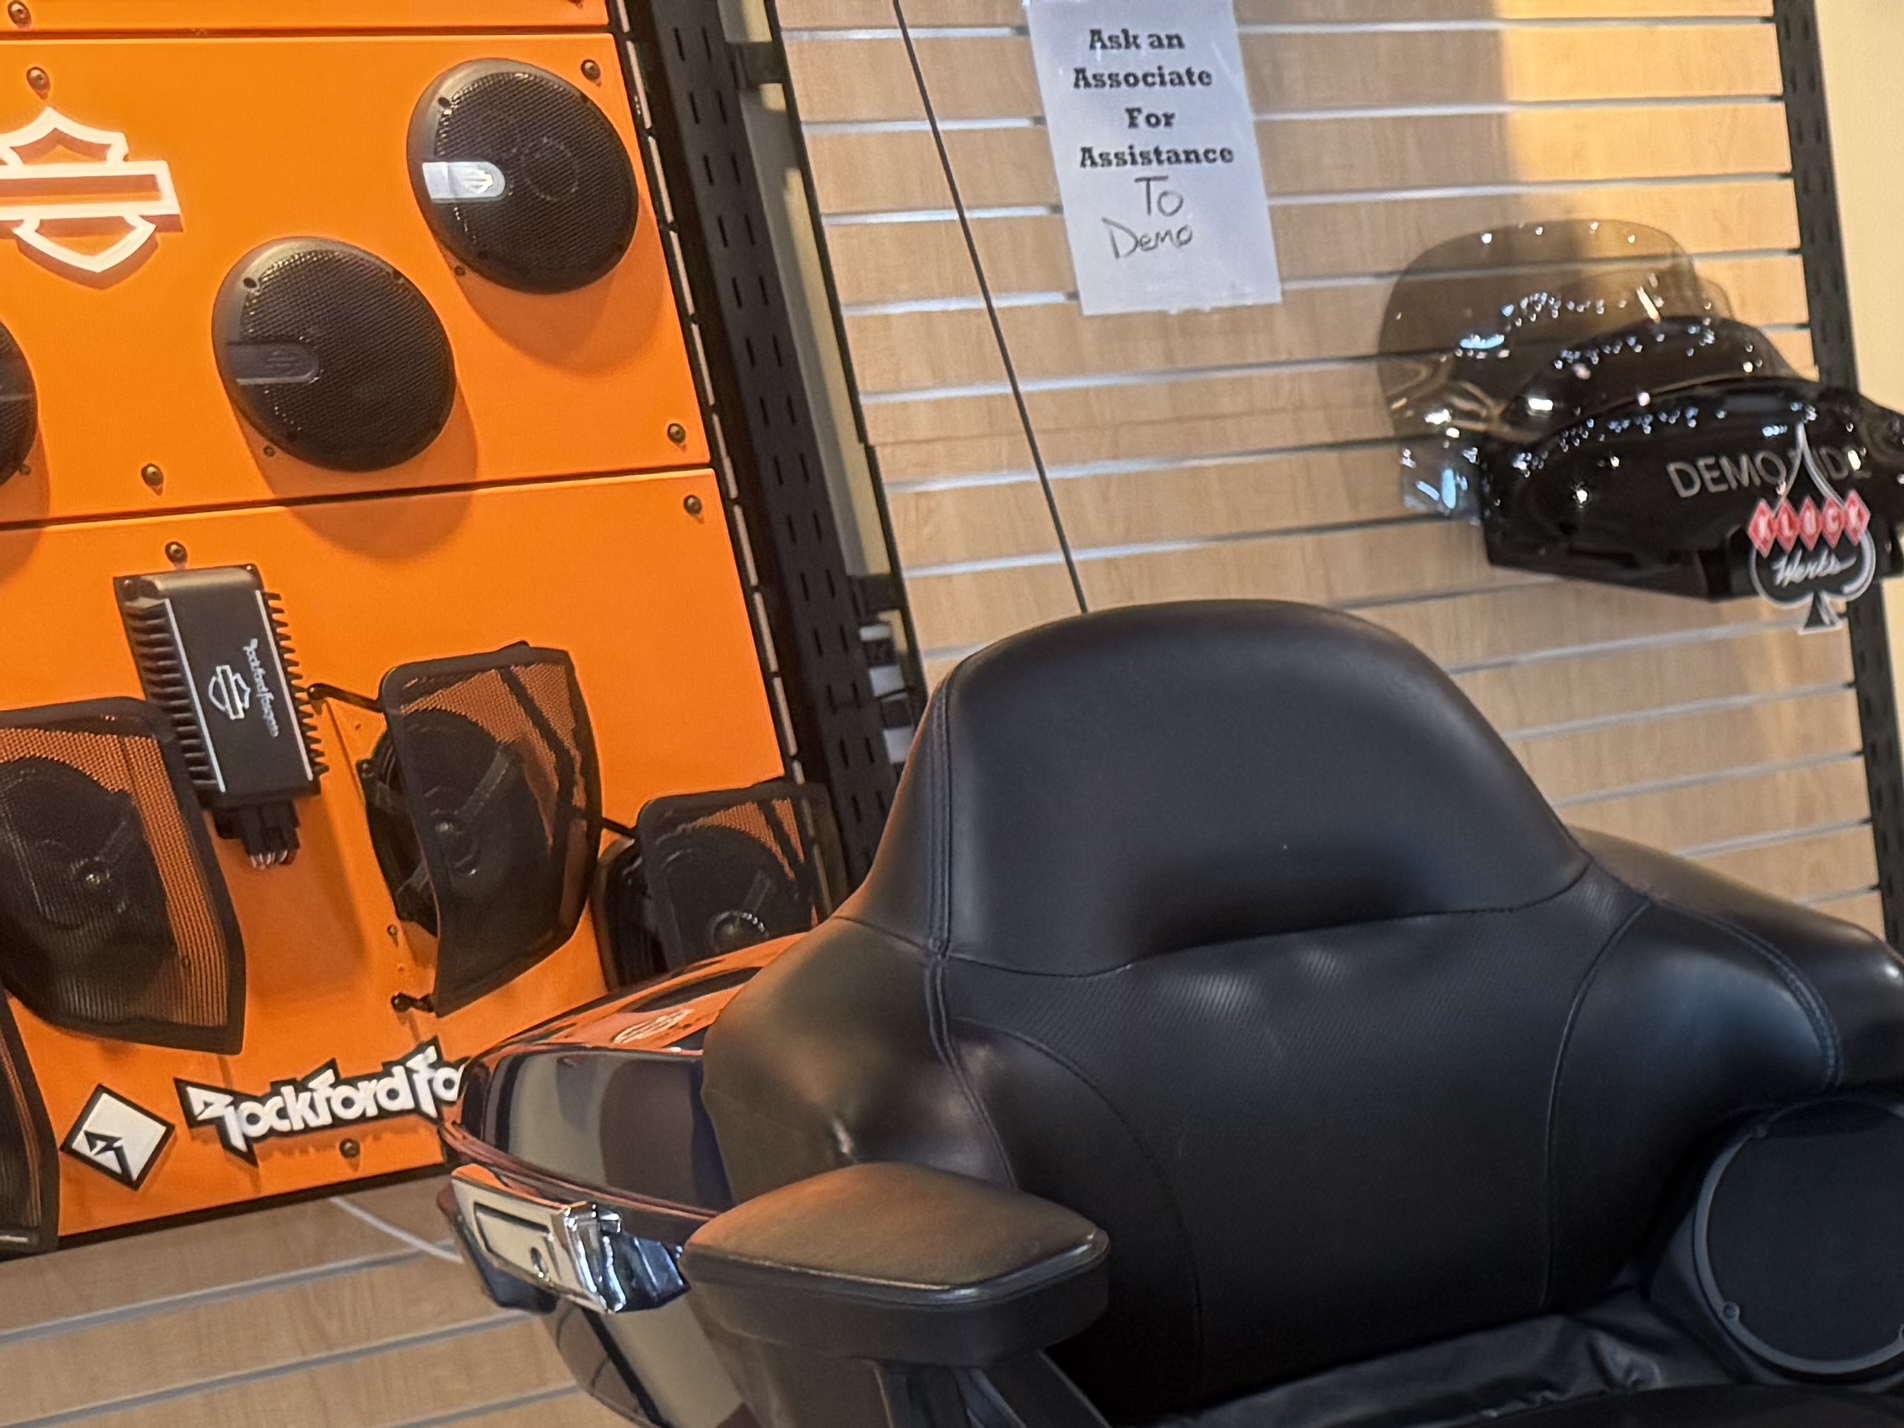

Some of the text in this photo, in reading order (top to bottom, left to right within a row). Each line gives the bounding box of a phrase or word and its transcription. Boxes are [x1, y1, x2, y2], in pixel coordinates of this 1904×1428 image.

[1089, 28, 1185, 50] Ask an
[1073, 65, 1213, 89] Associate
[1125, 107, 1176, 129] For
[1080, 144, 1235, 168] Assistance
[1134, 176, 1184, 217] To
[1102, 216, 1194, 260] Demo
[1667, 451, 1787, 498] DEMO
